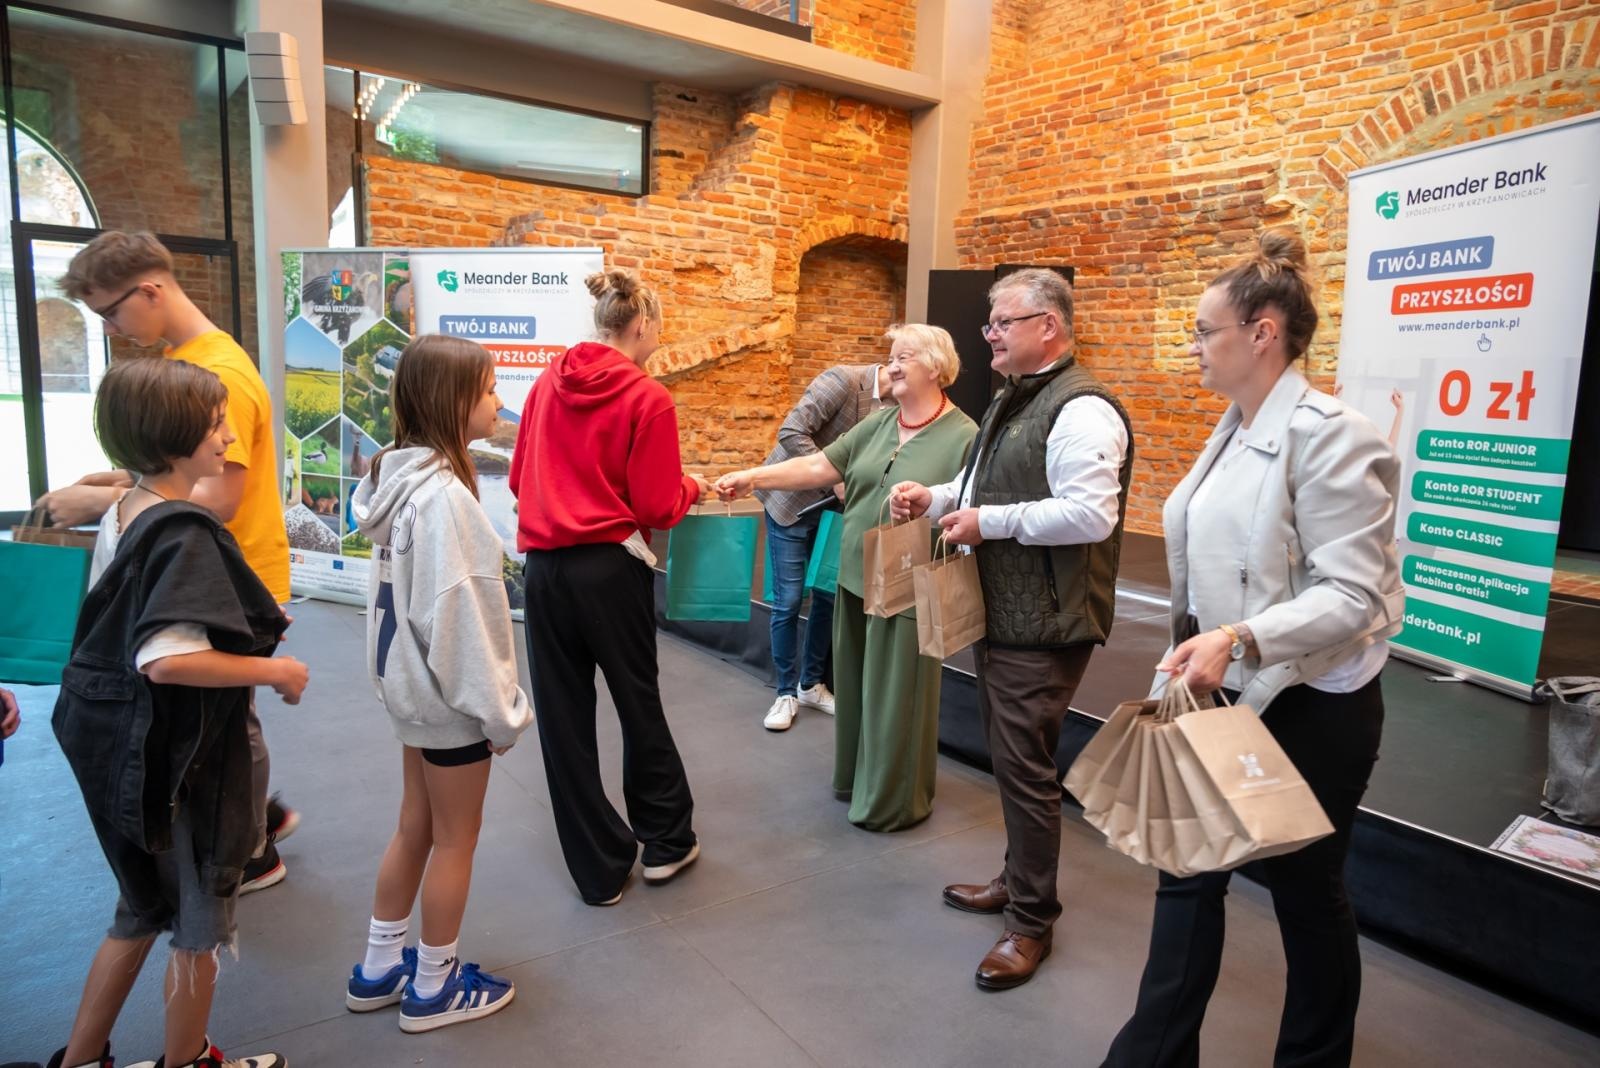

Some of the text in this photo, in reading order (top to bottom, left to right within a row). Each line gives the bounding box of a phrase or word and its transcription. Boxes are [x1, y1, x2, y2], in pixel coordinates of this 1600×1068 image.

[1406, 162, 1548, 206] Meander Bank
[1376, 246, 1483, 274] TWÓJ BANK
[464, 272, 568, 285] Meander Bank
[1399, 280, 1524, 309] PRZYSZŁOŚCI
[446, 318, 529, 335] TWÓJ BANK
[1398, 317, 1520, 332] www.meanderbank.pl
[1439, 370, 1536, 421] 0 zł
[1429, 437, 1537, 456] Konto ROR JUNIOR
[1424, 480, 1543, 505] Konto ROR STUDENT
[1420, 522, 1503, 547] Konto CLASSIC
[1414, 574, 1490, 599] Mobilna Gratis!
[1415, 561, 1530, 596] Nowoczesna Aplikacja
